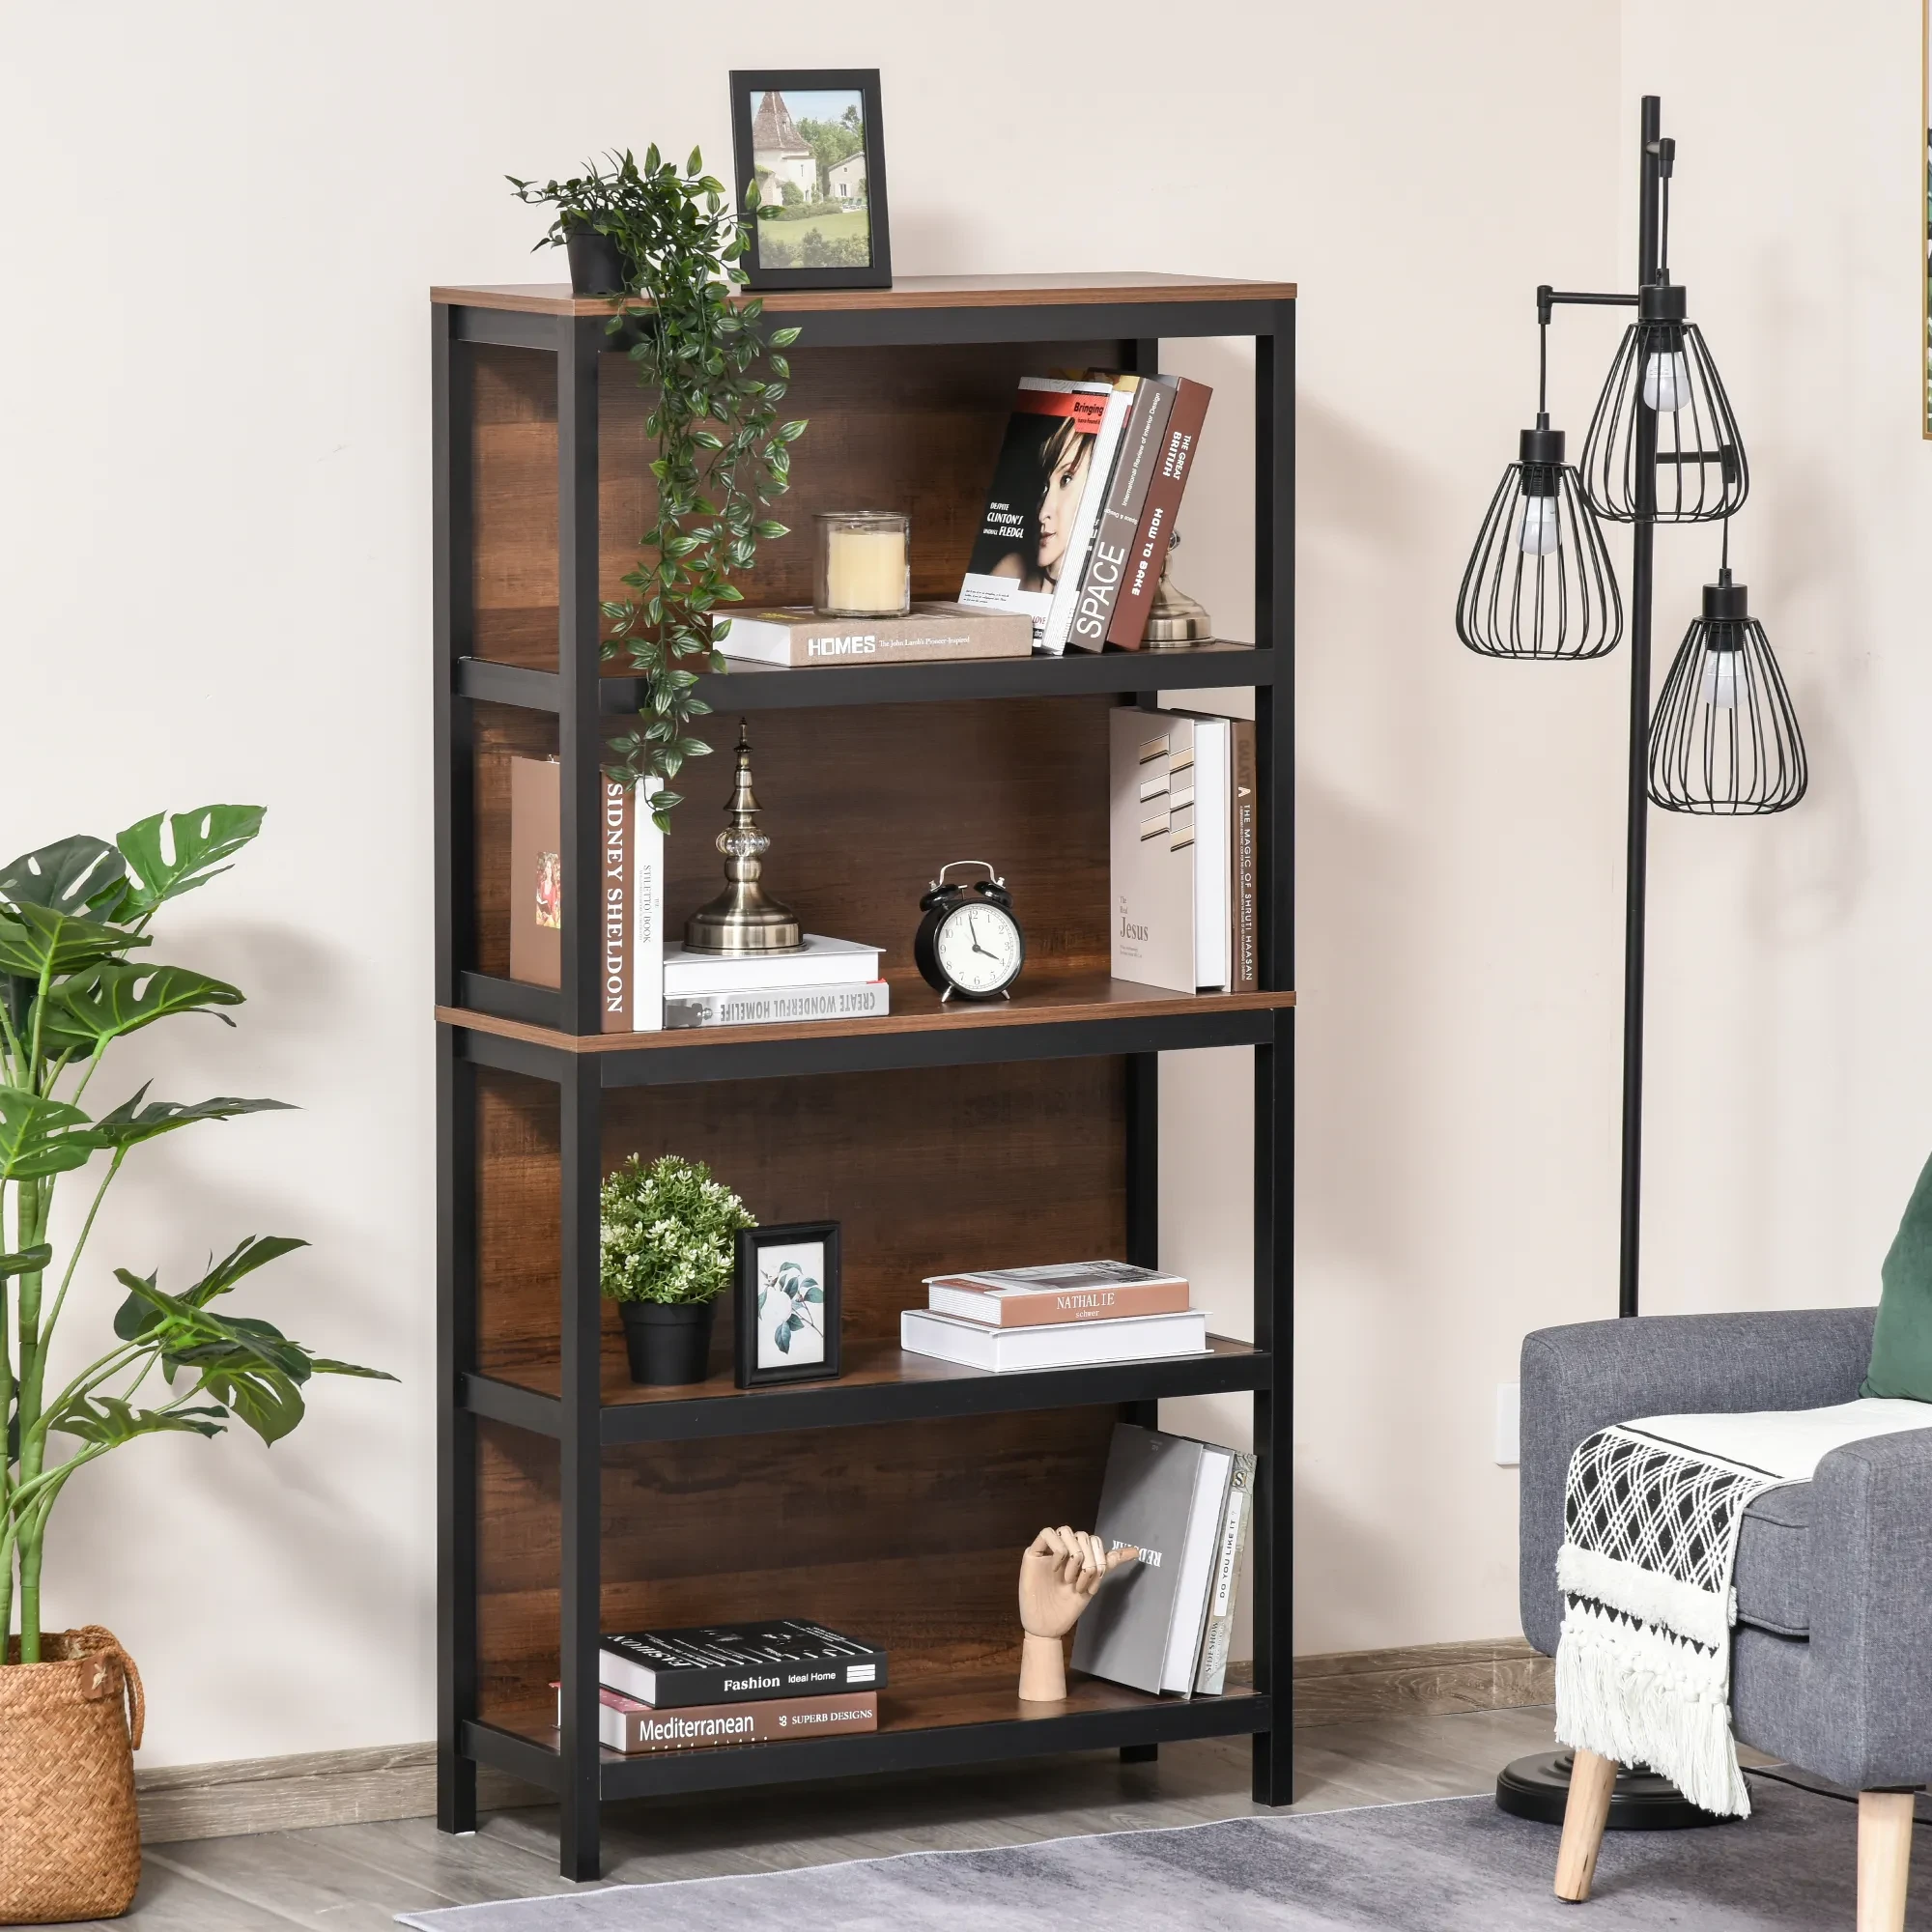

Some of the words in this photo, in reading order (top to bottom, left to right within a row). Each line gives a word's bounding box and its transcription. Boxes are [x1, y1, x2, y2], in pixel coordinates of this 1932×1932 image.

[1073, 402, 1104, 416] Bringing
[1150, 392, 1161, 414] Design
[1143, 414, 1153, 437] Interior
[1141, 436, 1147, 444] of
[1180, 435, 1192, 451] THE
[1133, 444, 1145, 469] Review
[1162, 431, 1181, 477] BRITISH
[1173, 451, 1186, 481] GREAT
[1122, 468, 1137, 506] International
[986, 512, 1024, 526] CLINTON'S
[1148, 507, 1164, 539] HOW
[1142, 542, 1154, 558] TO
[1131, 560, 1149, 596] BAKE
[1076, 541, 1125, 639] SPACE
[1032, 615, 1046, 625] LOVE
[808, 635, 876, 657] HOMES
[890, 639, 904, 648] John
[904, 638, 924, 647] Lamb's
[607, 782, 624, 882] SIDNEY
[1243, 828, 1252, 867] MAGIC
[1244, 872, 1252, 888] OF
[954, 916, 963, 926] 11
[998, 924, 1005, 935] 2
[1120, 916, 1149, 942] Jesus
[945, 928, 954, 939] 10
[607, 888, 623, 1013] SHELDON
[940, 945, 947, 954] 9
[1004, 942, 1010, 952] 3
[946, 961, 952, 970] 8
[999, 957, 1006, 967] 4
[958, 971, 965, 981] 7
[974, 976, 980, 985] 6
[990, 971, 996, 980] 5
[720, 1000, 771, 1022] HOMELIFE
[773, 996, 838, 1017] WONDERFUL
[839, 992, 876, 1012] CREATE
[1056, 1292, 1116, 1310] NATHALIE
[1075, 1309, 1100, 1318] schwer
[1235, 1471, 1245, 1486] S
[1229, 1520, 1236, 1529] IT
[1226, 1533, 1235, 1556] LIKE
[1219, 1583, 1227, 1599] DO
[1206, 1623, 1218, 1672] SIDESHOW
[724, 1676, 781, 1691] Fashion
[787, 1673, 809, 1684] Ideal
[810, 1671, 837, 1681] Home
[639, 1716, 754, 1742] Mediterranean
[791, 1713, 829, 1725] SUPERB
[830, 1709, 873, 1722] DESIGNS
